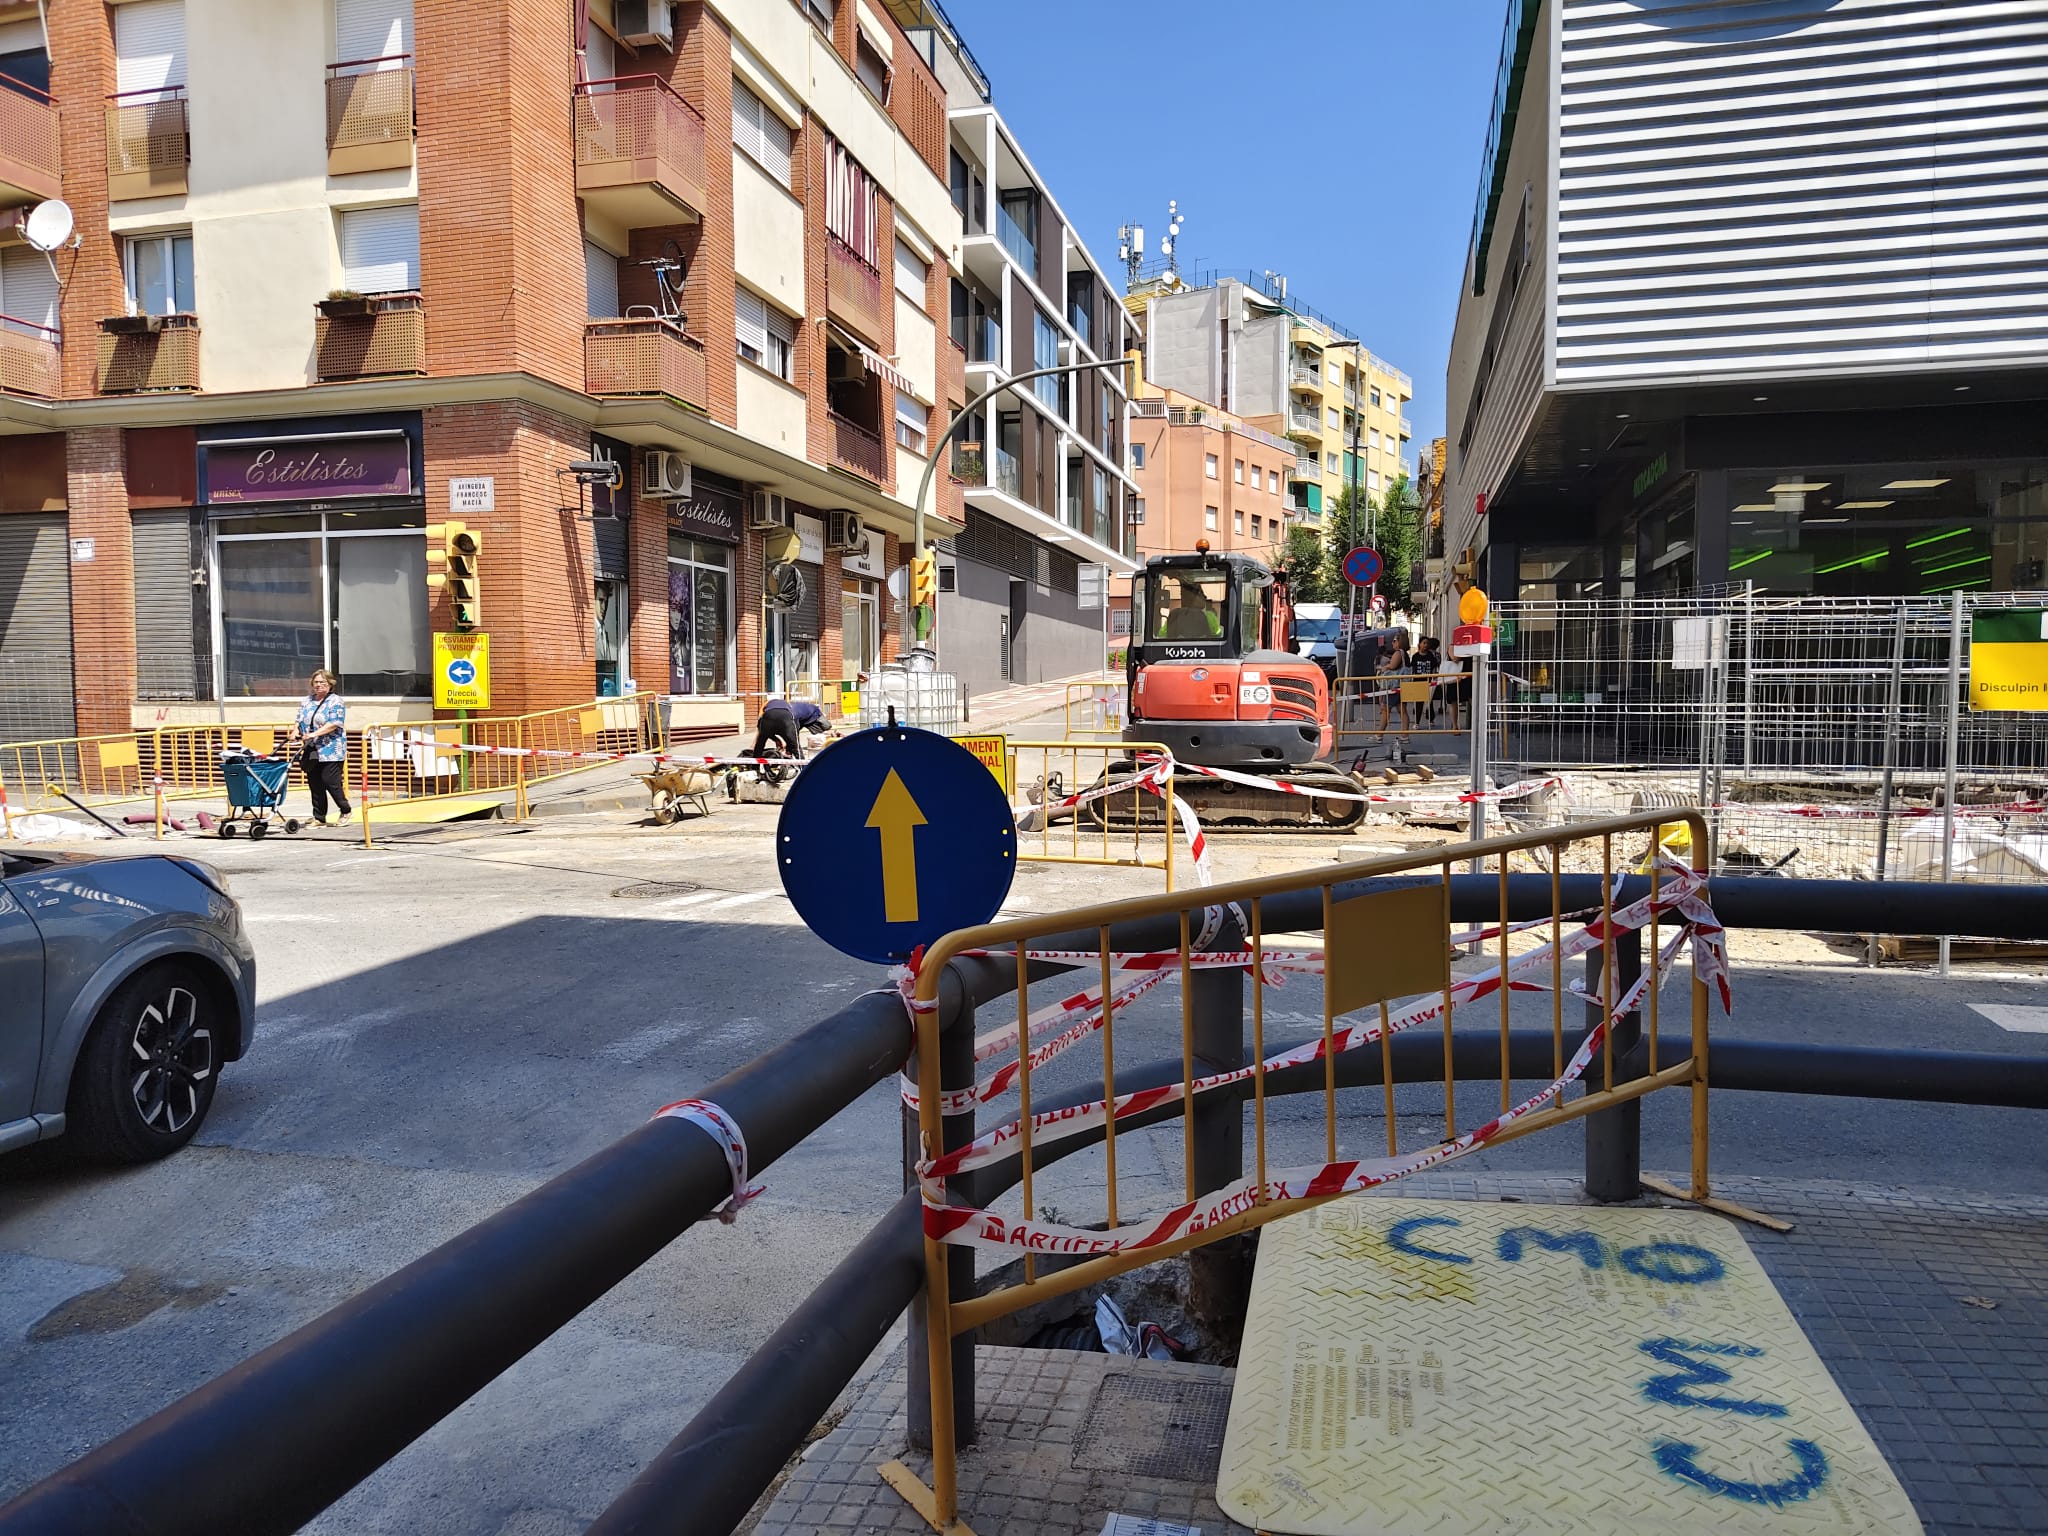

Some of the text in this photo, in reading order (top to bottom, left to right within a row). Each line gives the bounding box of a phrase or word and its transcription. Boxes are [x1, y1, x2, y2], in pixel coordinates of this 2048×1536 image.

[246, 449, 368, 485] Estilistes
[213, 486, 244, 499] unisex
[456, 491, 488, 499] FRANCESC
[857, 561, 871, 571] NAILS
[438, 636, 485, 644] DESVIAMENT
[437, 643, 486, 651] PROVISIONAL
[1165, 647, 1206, 658] Kubota
[1980, 683, 2039, 694] Disculpin
[961, 741, 999, 753] AMENT
